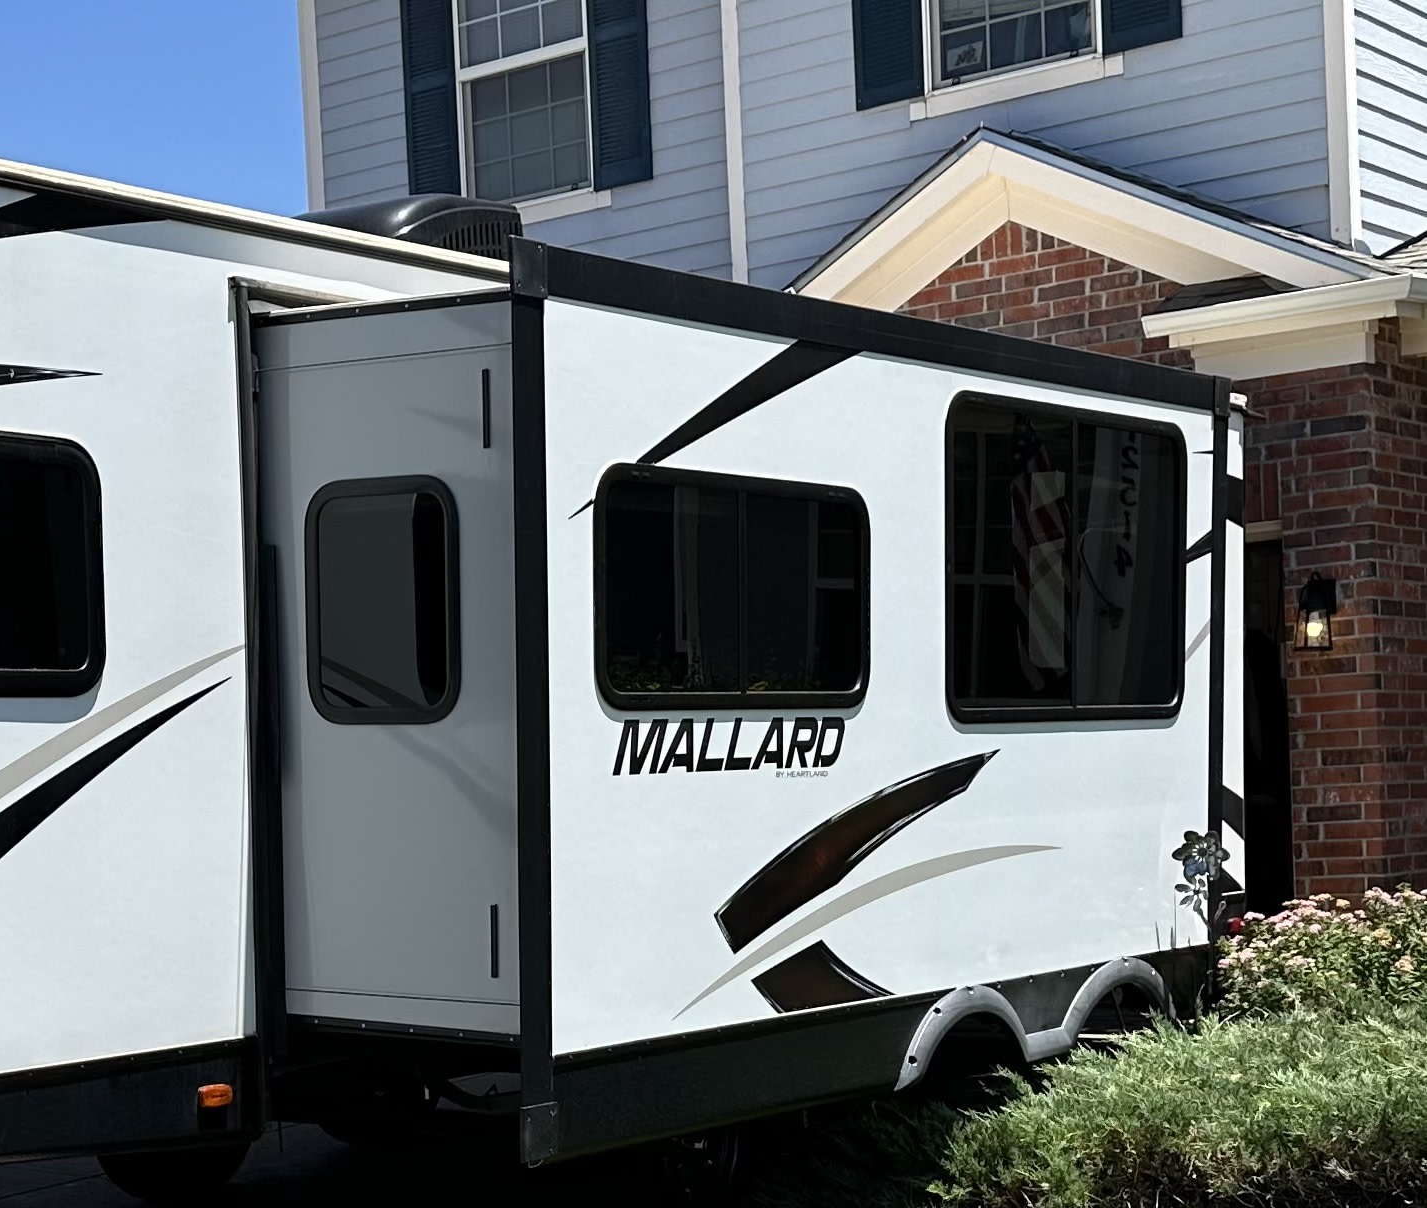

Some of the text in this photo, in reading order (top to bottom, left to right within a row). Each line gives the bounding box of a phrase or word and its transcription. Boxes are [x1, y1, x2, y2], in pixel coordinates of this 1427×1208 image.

[612, 716, 846, 776] MALLARD
[775, 770, 829, 778] BY HEARTLAND
